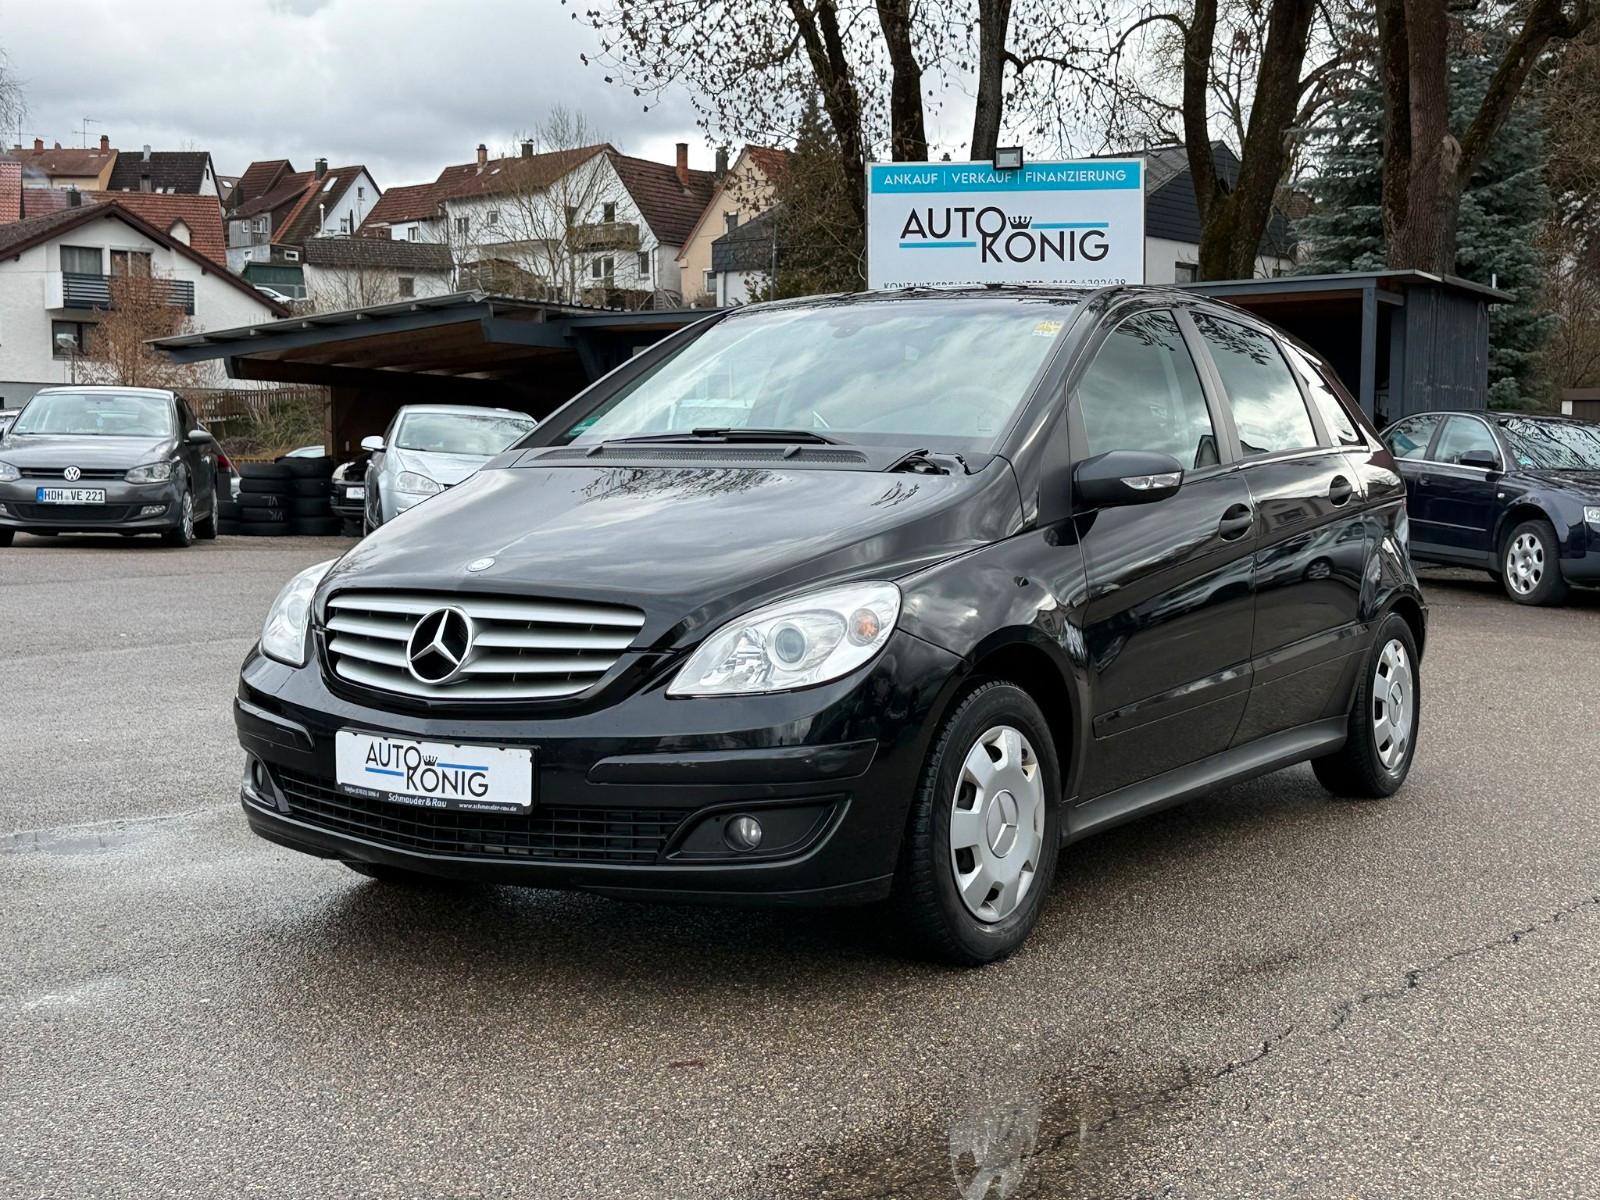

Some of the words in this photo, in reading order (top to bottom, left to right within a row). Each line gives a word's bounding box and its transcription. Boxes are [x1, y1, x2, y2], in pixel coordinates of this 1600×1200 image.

[884, 172, 938, 185] ANKAUF
[951, 171, 1012, 184] VERKAUF
[1025, 169, 1127, 183] FINANZIERUNG
[900, 206, 1007, 239] AUTO
[45, 490, 63, 501] HDH
[70, 490, 83, 501] VE
[86, 491, 103, 502] 221
[366, 741, 421, 769] AUTO
